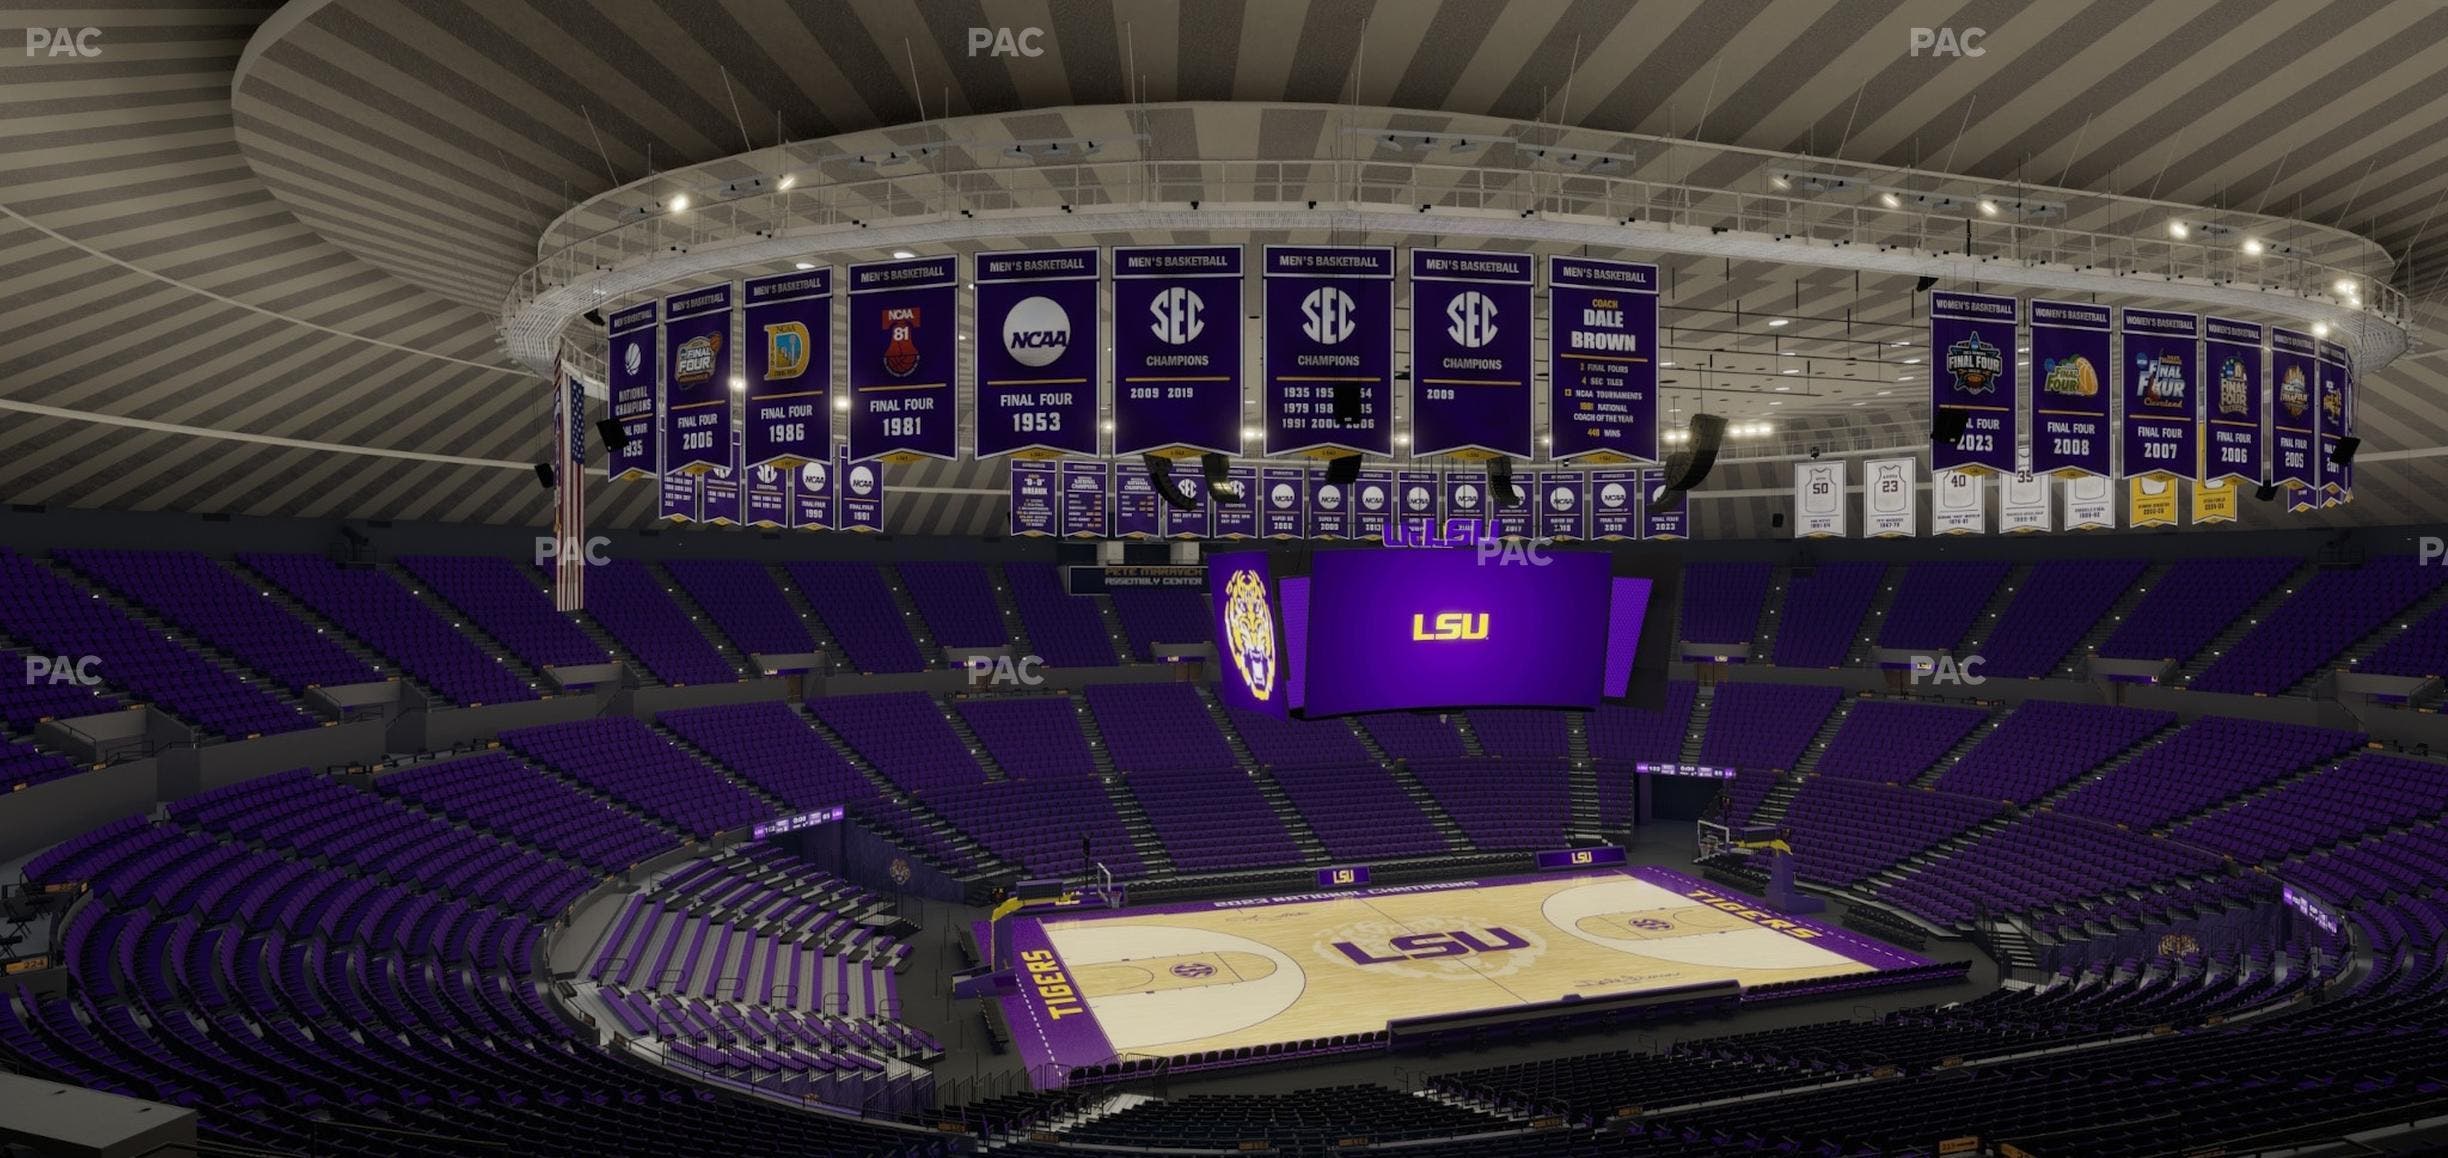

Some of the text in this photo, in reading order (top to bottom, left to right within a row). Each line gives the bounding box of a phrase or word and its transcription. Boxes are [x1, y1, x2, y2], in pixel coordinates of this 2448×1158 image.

[990, 258, 1084, 272] MEN'S BASKETBALL
[1128, 256, 1228, 268] MEN'S BASKETBALL
[1280, 255, 1378, 268] MEN'S BASKETBALL
[1426, 258, 1519, 274] MEN'S BASKETBALL
[861, 266, 944, 283] MEN'S BASKETBALL
[1563, 266, 1647, 284] MEN'S BASKETBALL
[753, 277, 821, 297] MEN'S BASKETBALL
[1592, 299, 1618, 309] COACH
[1936, 299, 2013, 315] WOMEN'S BASKETBALL
[888, 308, 914, 320] NCAA
[1150, 286, 1205, 345] SEC
[1301, 286, 1356, 345] SEC
[1446, 291, 1498, 348] SEC
[1583, 308, 1624, 328] DALE
[2035, 307, 2107, 323] WOMEN'S BASKETBALL
[2126, 315, 2194, 330] WOMEN'S BASKETBALL
[893, 326, 909, 341] 81
[1010, 330, 1068, 349] NCAA
[1571, 331, 1636, 352] BROWN
[679, 356, 711, 373] FOUR
[1146, 355, 1209, 366] CHAMPIONS
[1297, 355, 1360, 367] CHAMPIONS
[1443, 357, 1502, 370] CHAMPIONS
[1949, 355, 2000, 373] FINAL FOUR
[1590, 377, 1603, 386] SEC
[1000, 393, 1073, 407] FINAL FOUR
[1130, 387, 1194, 399] 2009 2019
[1284, 387, 1310, 398] 1935
[1426, 389, 1455, 400] 2009
[1575, 389, 1593, 398] NCAA
[761, 405, 813, 420] FINAL FOUR
[870, 398, 934, 412] FINAL FOUR
[1284, 403, 1309, 413] 1979
[678, 413, 718, 428] FINAL FOUR
[1012, 412, 1061, 432] 1953
[1282, 418, 1305, 428] 1991
[1573, 412, 1595, 421] COACH
[1976, 418, 2000, 430] FOUR
[769, 423, 805, 442] 1986
[882, 417, 921, 436] 1981
[2047, 421, 2095, 435] FINAL FOUR
[2138, 426, 2183, 439] FINAL FOUR
[683, 430, 713, 450] 2006
[1956, 434, 1993, 452] 2023
[2217, 431, 2251, 444] FINAL FOUR
[2053, 438, 2090, 456] 2008
[2144, 442, 2177, 460] 2007
[2221, 447, 2248, 464] 2006
[1812, 482, 1829, 494] 50
[1882, 480, 1898, 493] 23
[1951, 474, 1966, 488] 40
[1105, 577, 1202, 585] ASSEMBLY CENTER
[1413, 613, 1489, 641] LSU
[1572, 851, 1592, 865] LSU
[1333, 869, 1354, 884] LSU
[1271, 889, 1367, 902] NATIONAL
[1368, 880, 1479, 894] CHAMPIONS
[1686, 890, 1823, 940] TIGERS
[1331, 927, 1531, 966] LSU
[1020, 949, 1084, 1021] TIGERS
